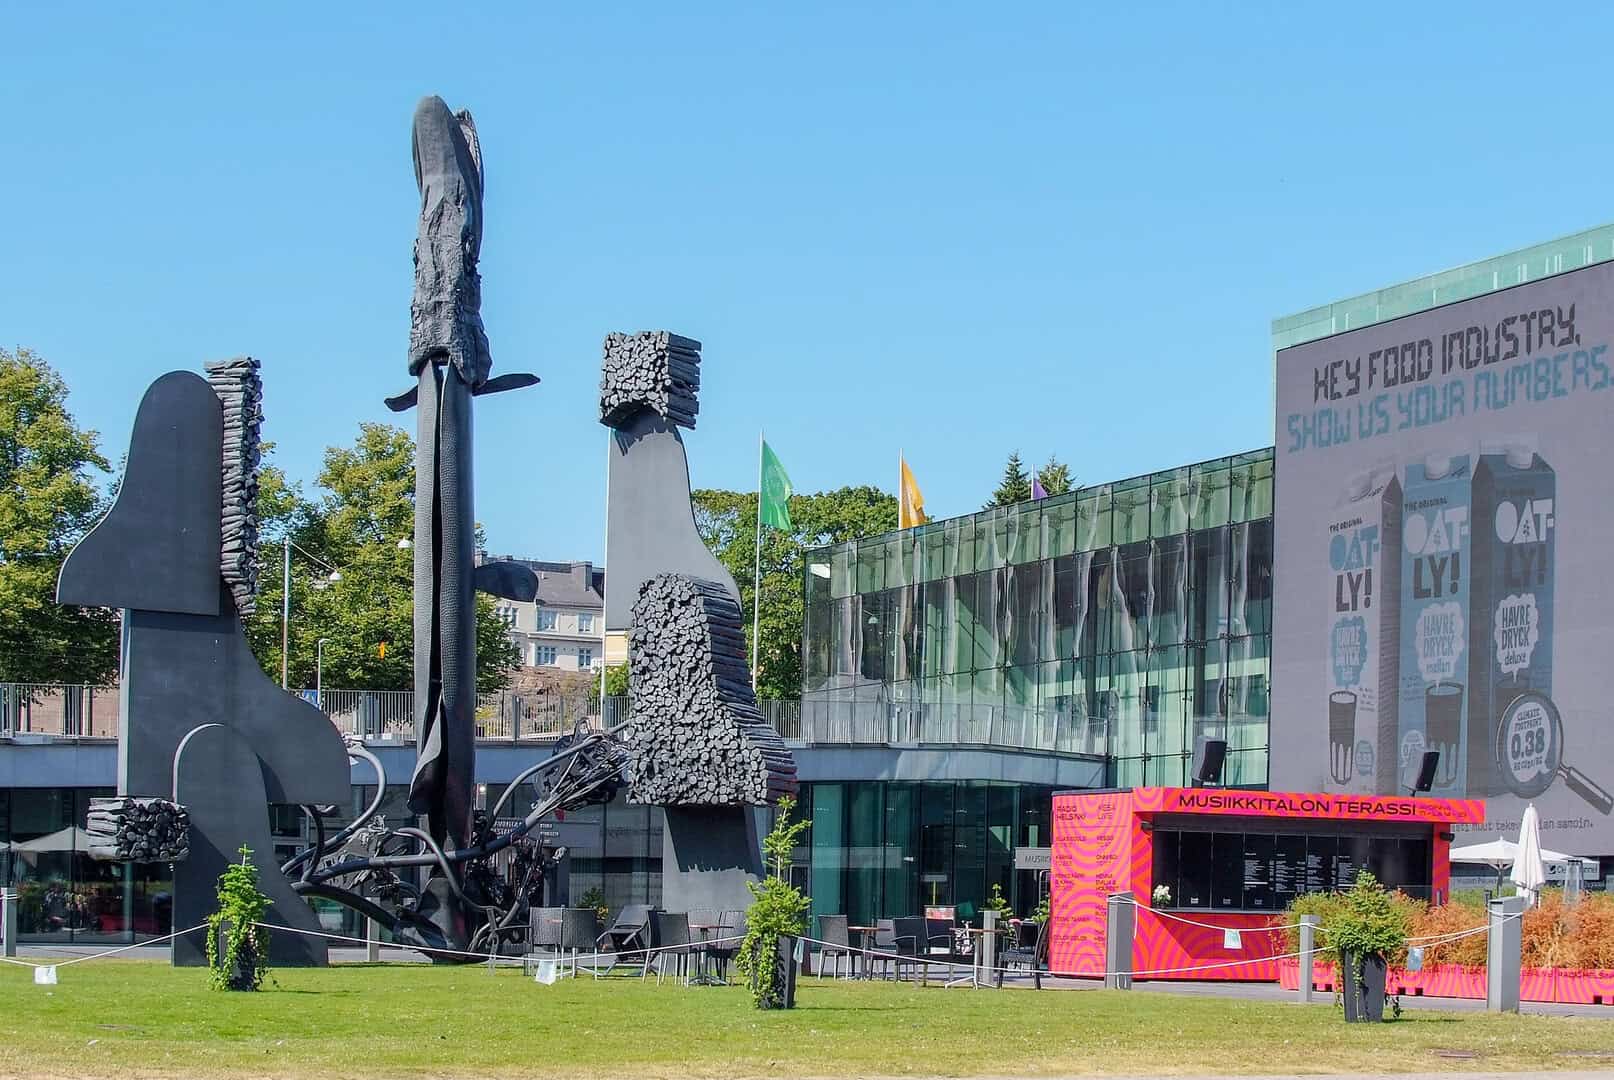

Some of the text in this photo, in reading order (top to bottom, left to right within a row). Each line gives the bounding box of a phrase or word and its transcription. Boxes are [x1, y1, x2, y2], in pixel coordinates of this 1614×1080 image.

[1314, 356, 1360, 404] HEY
[1368, 338, 1433, 390] FOOD
[1288, 406, 1351, 452] SHOW
[1359, 394, 1390, 438] US
[1397, 378, 1465, 430] YOUR
[1336, 568, 1372, 612] LY!
[1413, 552, 1460, 600] LY!
[1502, 604, 1531, 628] HAVRE
[1501, 626, 1530, 650] DRYCK
[1511, 727, 1545, 760] 0.38
[1179, 795, 1330, 812] MUSIIKKITALON
[1335, 800, 1416, 816] TERASSI
